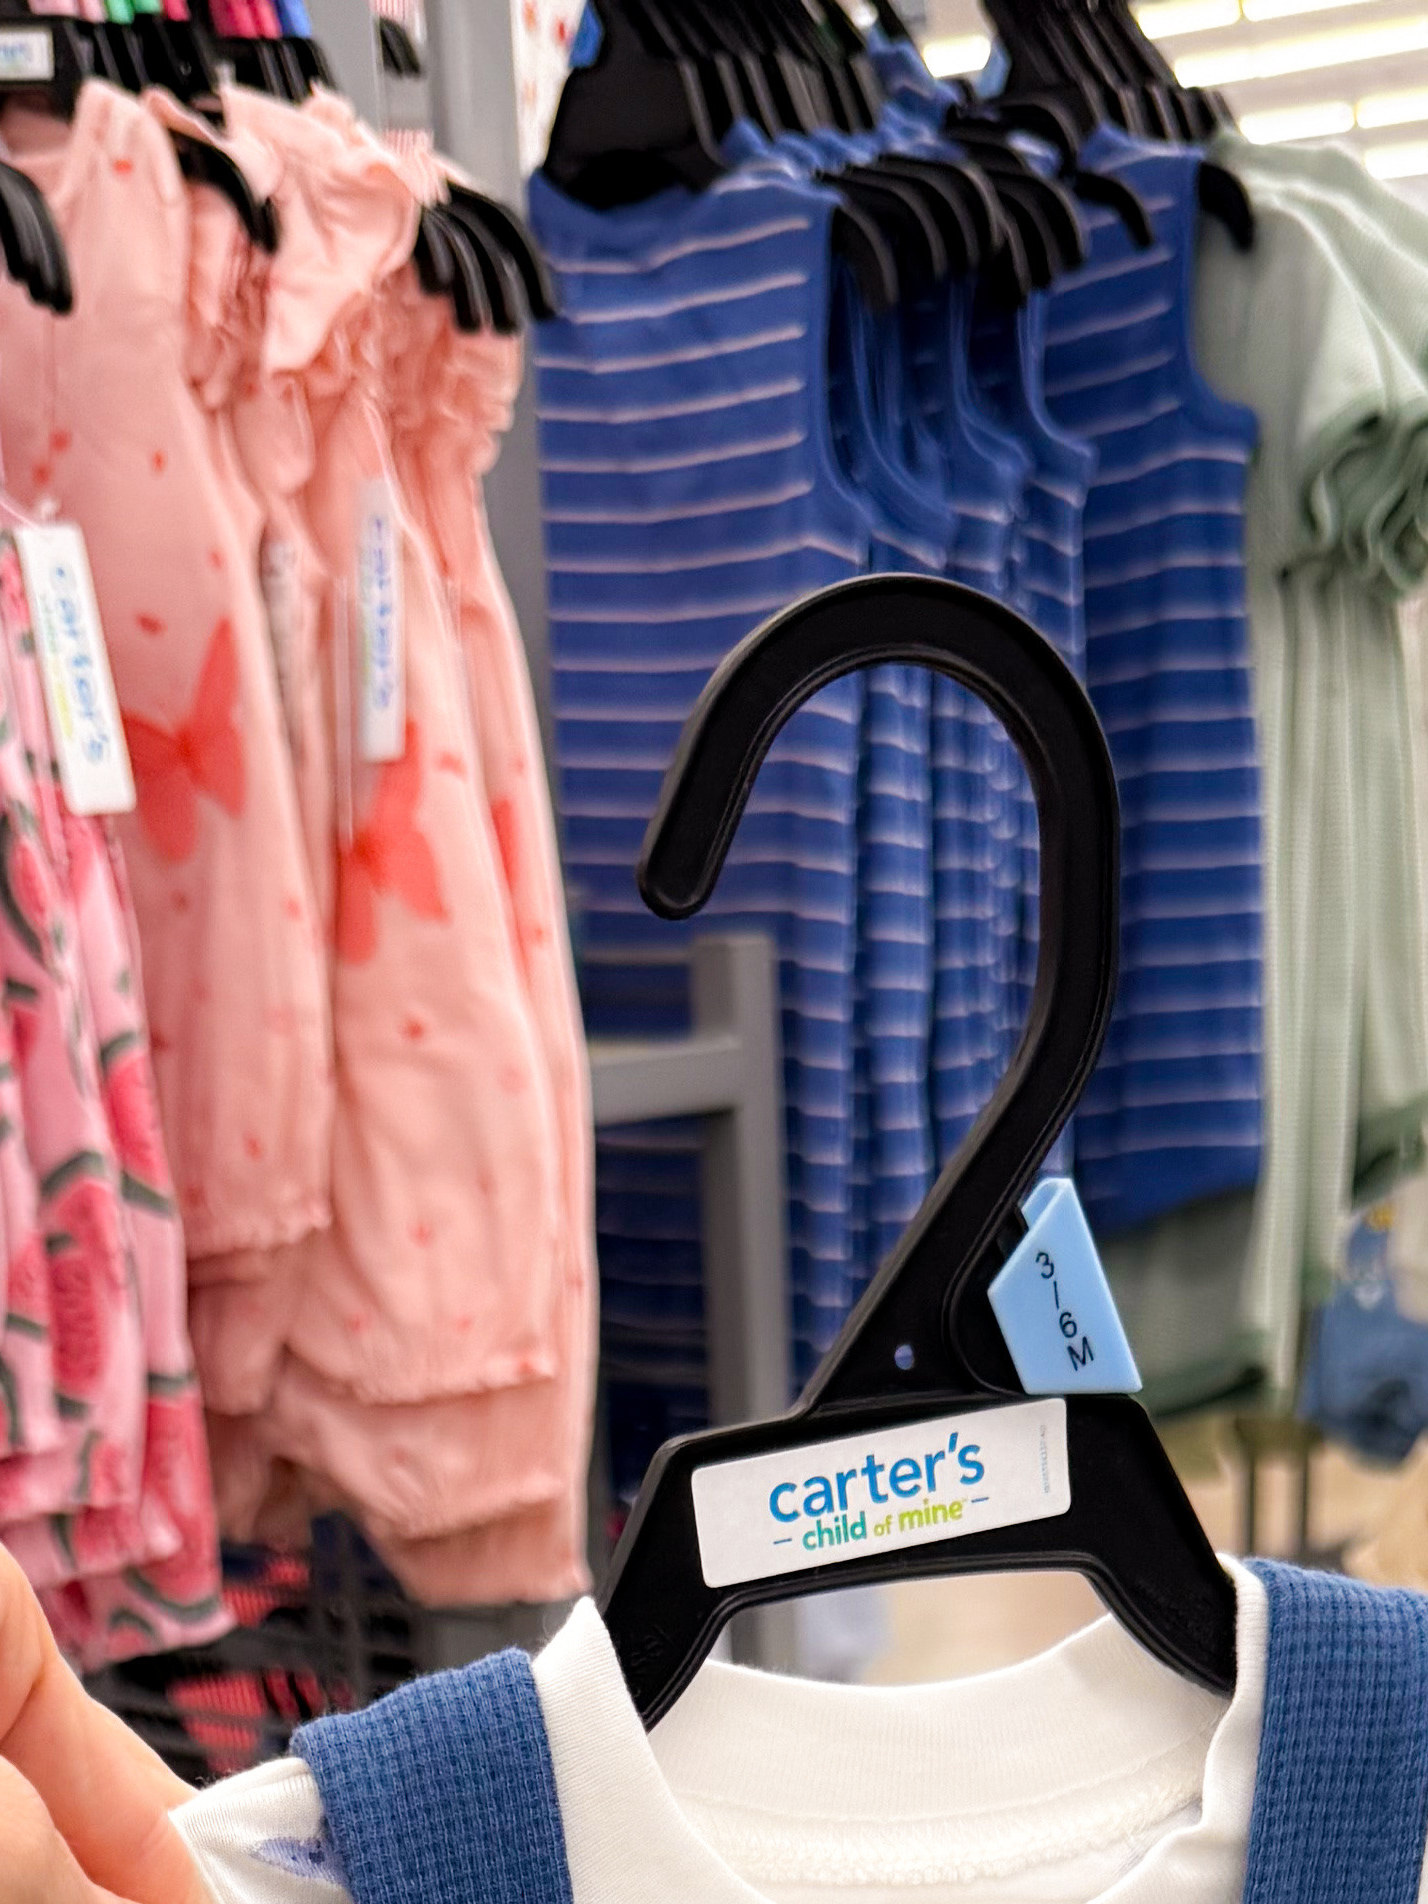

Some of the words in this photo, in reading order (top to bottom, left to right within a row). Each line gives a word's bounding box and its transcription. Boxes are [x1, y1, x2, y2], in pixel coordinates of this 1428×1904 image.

[769, 1431, 985, 1523] carter's
[802, 1510, 868, 1551] child
[874, 1515, 894, 1537] of
[898, 1498, 964, 1532] mine
